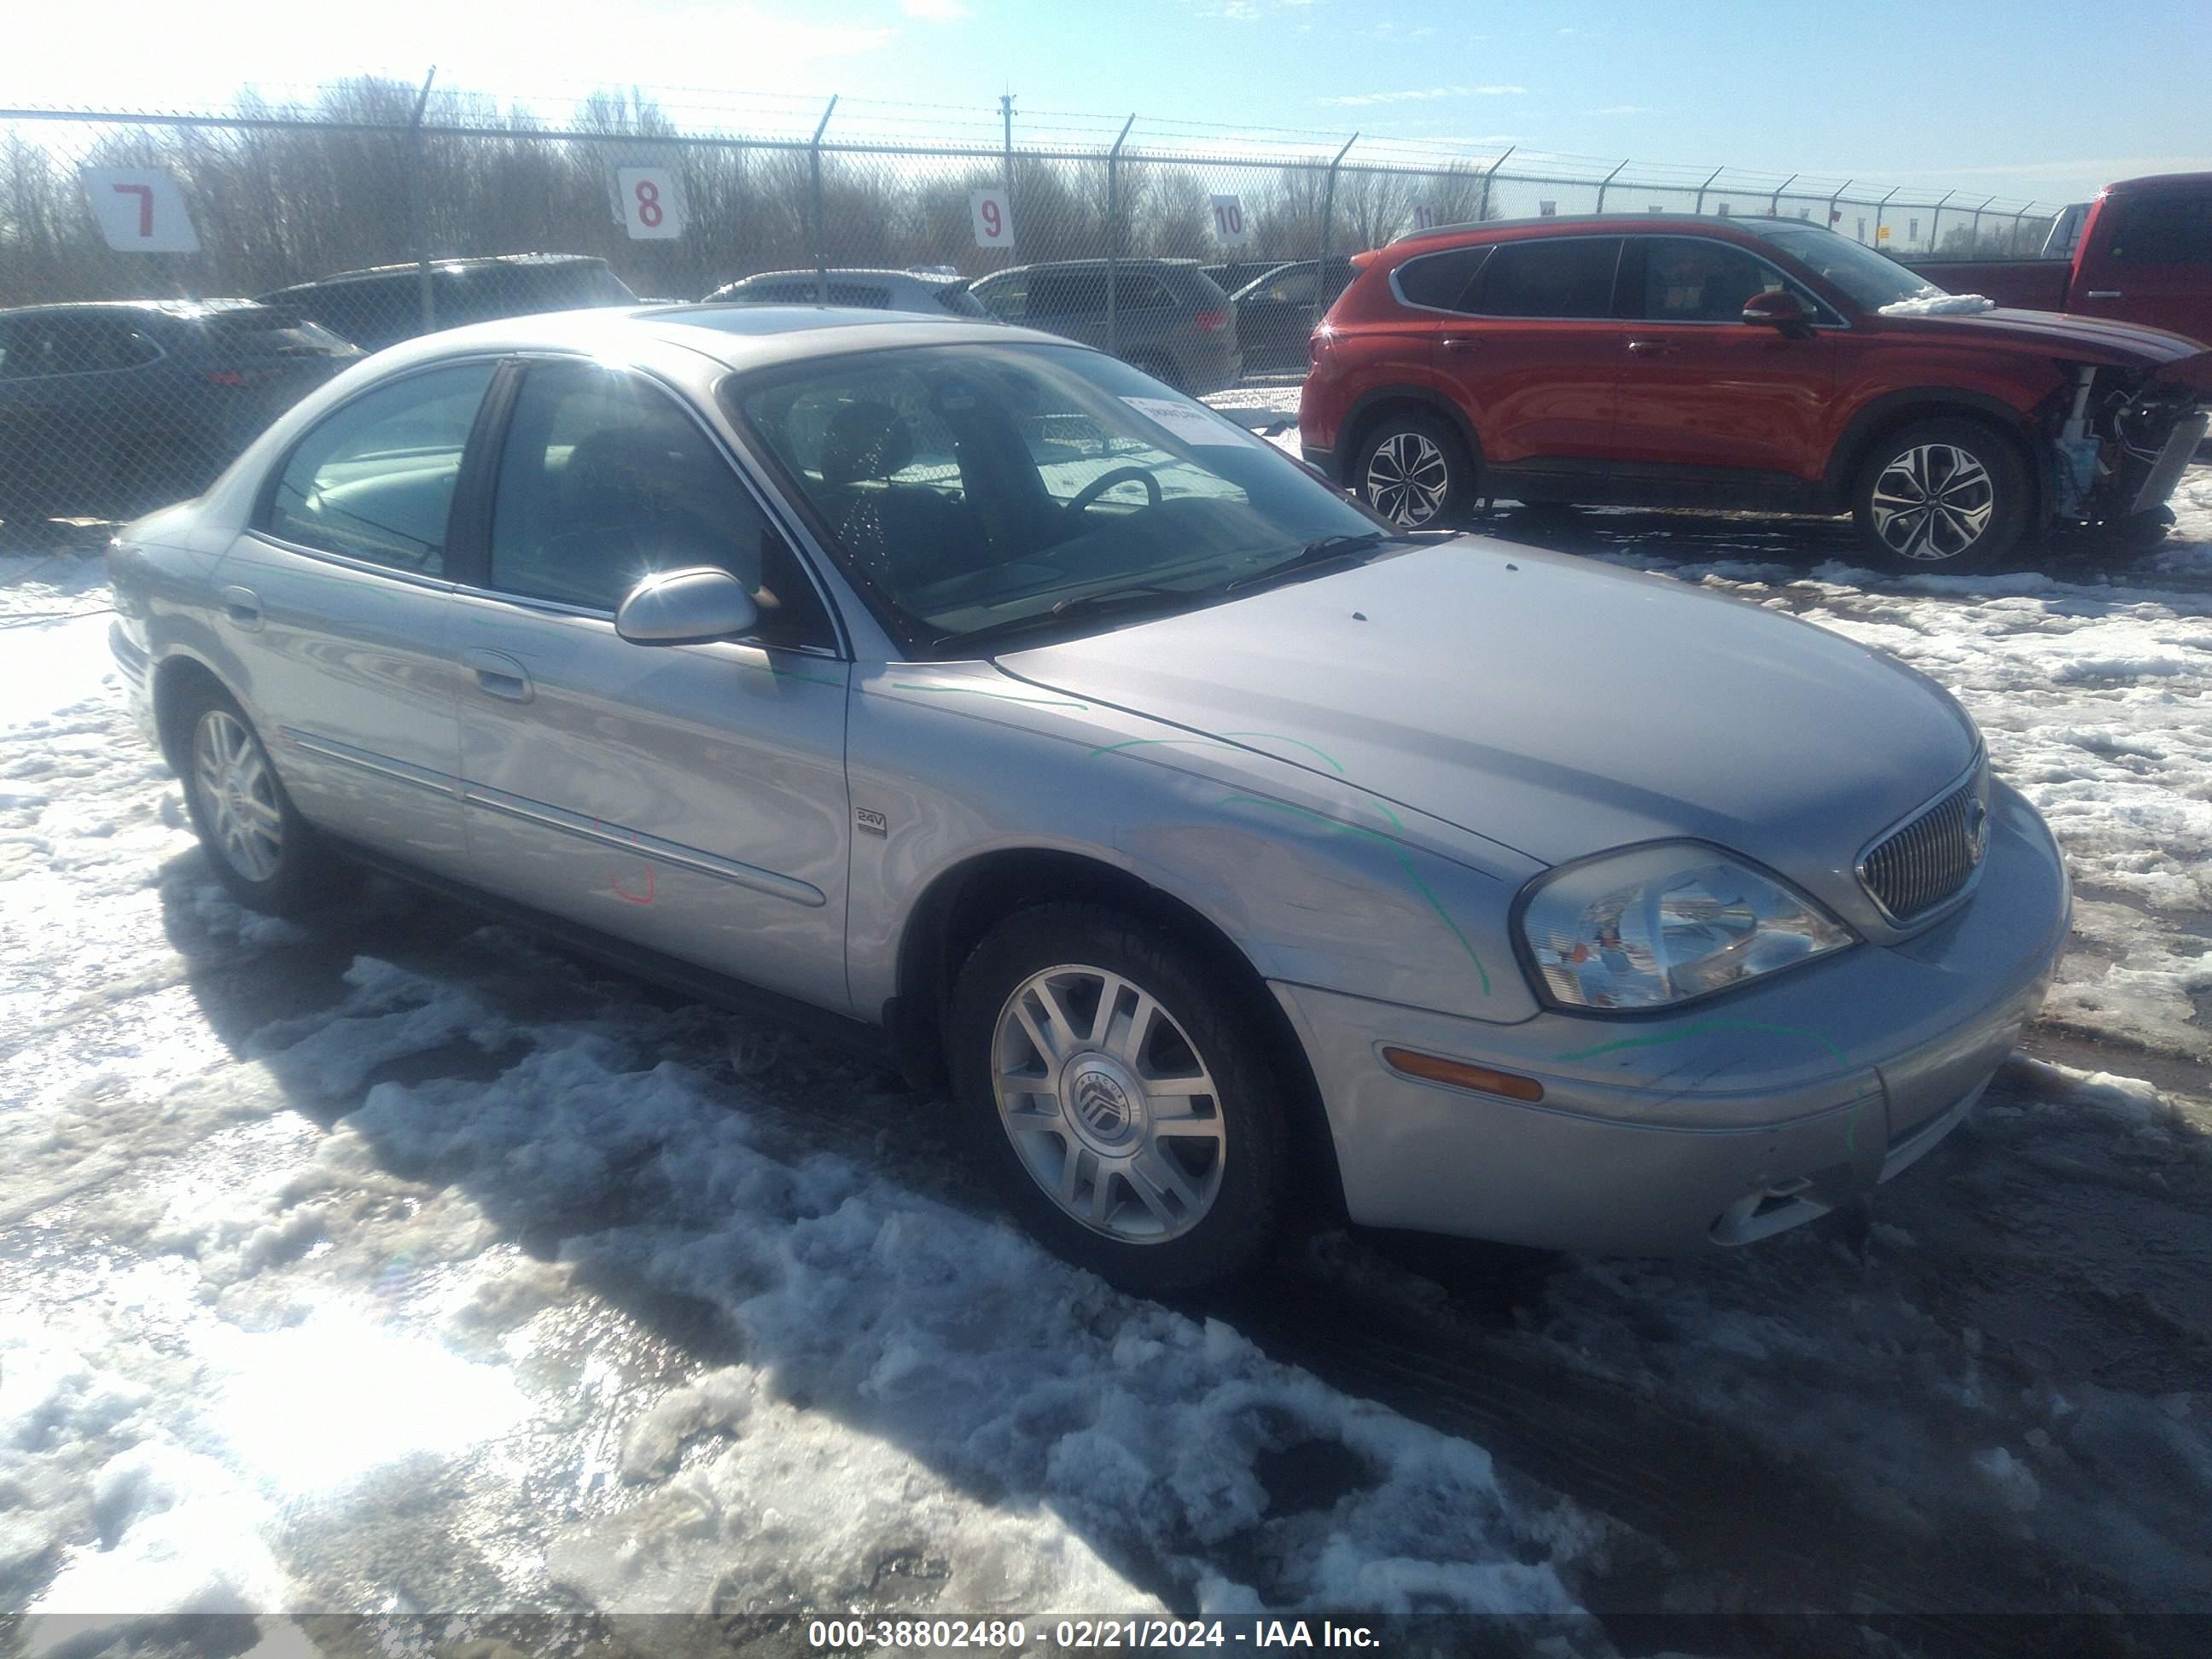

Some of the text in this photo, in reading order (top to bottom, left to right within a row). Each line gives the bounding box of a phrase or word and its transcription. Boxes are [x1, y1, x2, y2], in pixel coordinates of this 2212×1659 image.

[112, 183, 152, 237] 7
[635, 180, 663, 228] 8
[981, 199, 1002, 238] 9
[1215, 205, 1243, 234] 10
[857, 811, 882, 825] 24V
[1080, 1074, 1127, 1108] MERCURY
